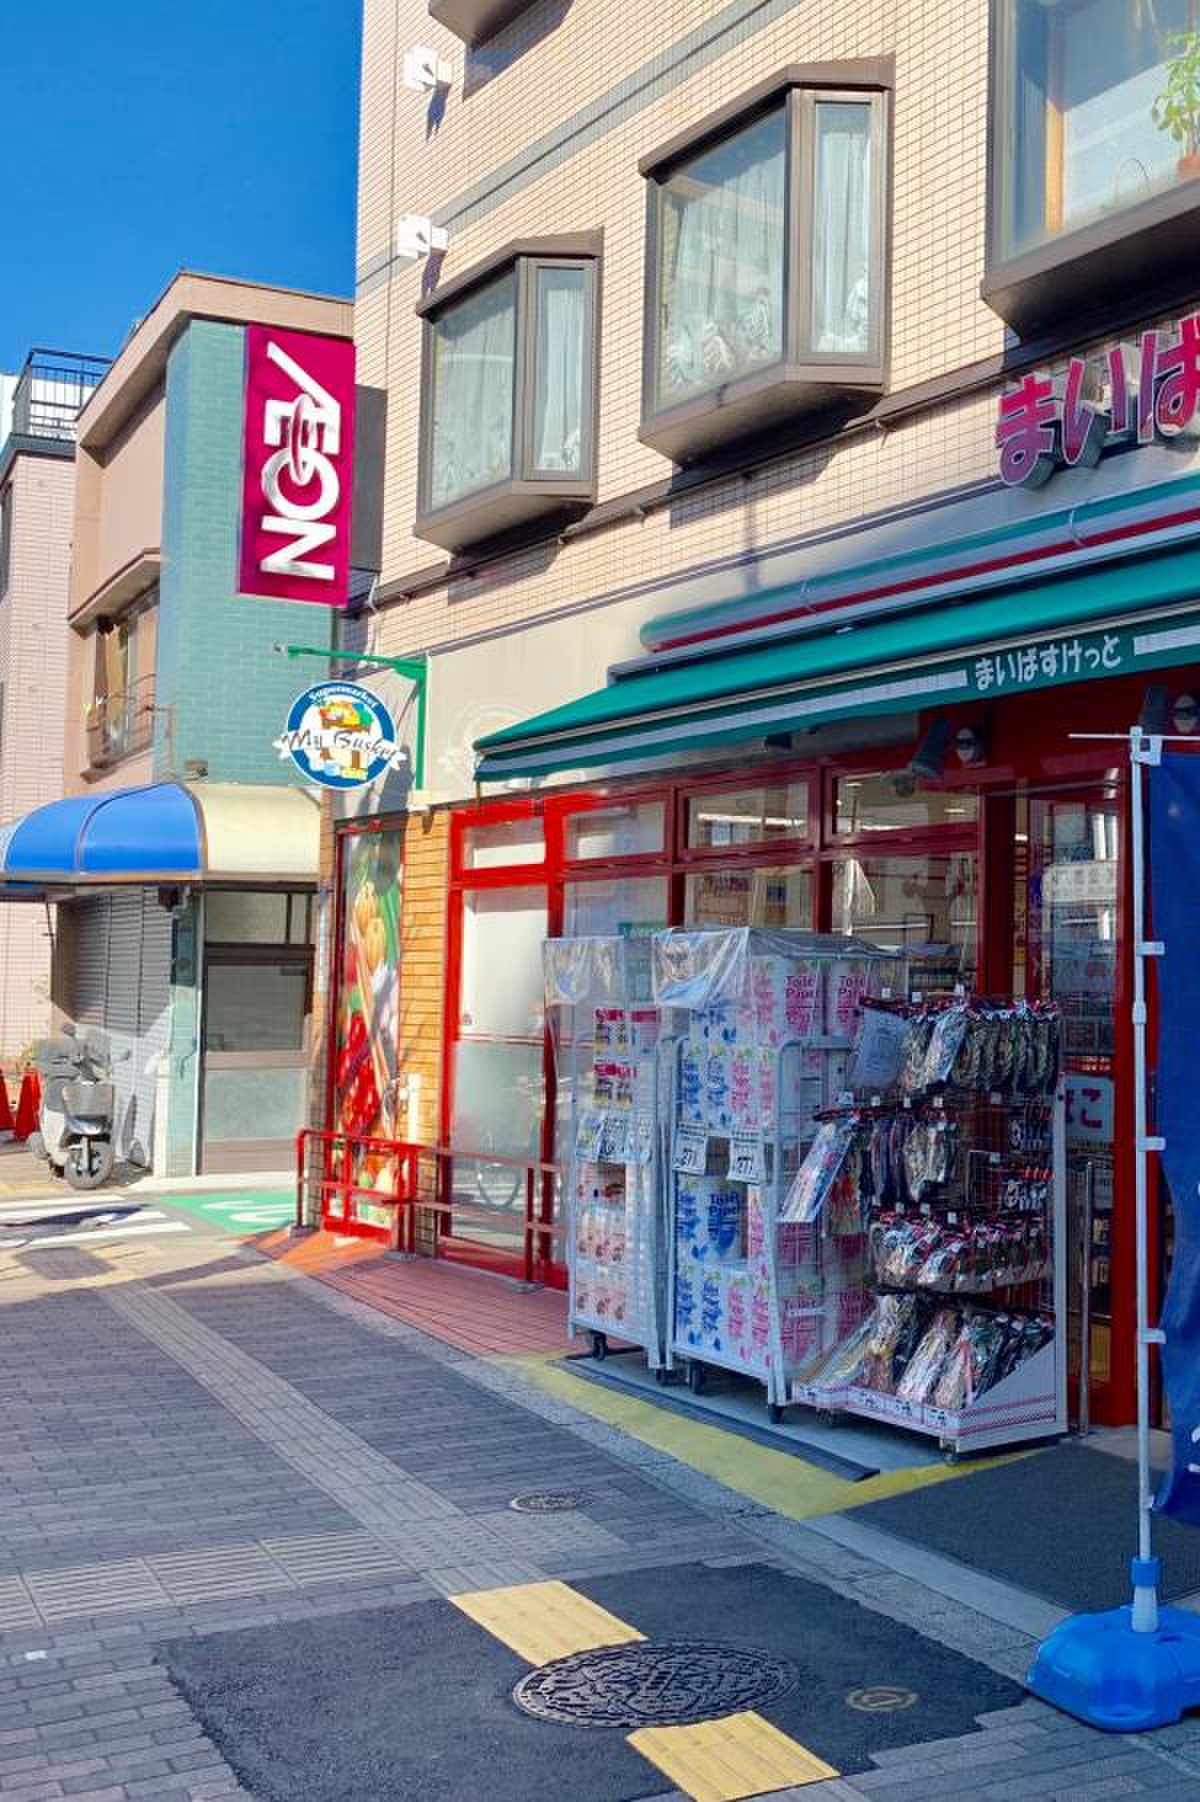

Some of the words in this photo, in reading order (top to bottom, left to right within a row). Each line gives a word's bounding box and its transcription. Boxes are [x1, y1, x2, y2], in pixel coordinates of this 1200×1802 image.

[261, 341, 341, 580] AEON
[974, 634, 1122, 691] まいばすけっと
[280, 728, 322, 751] My
